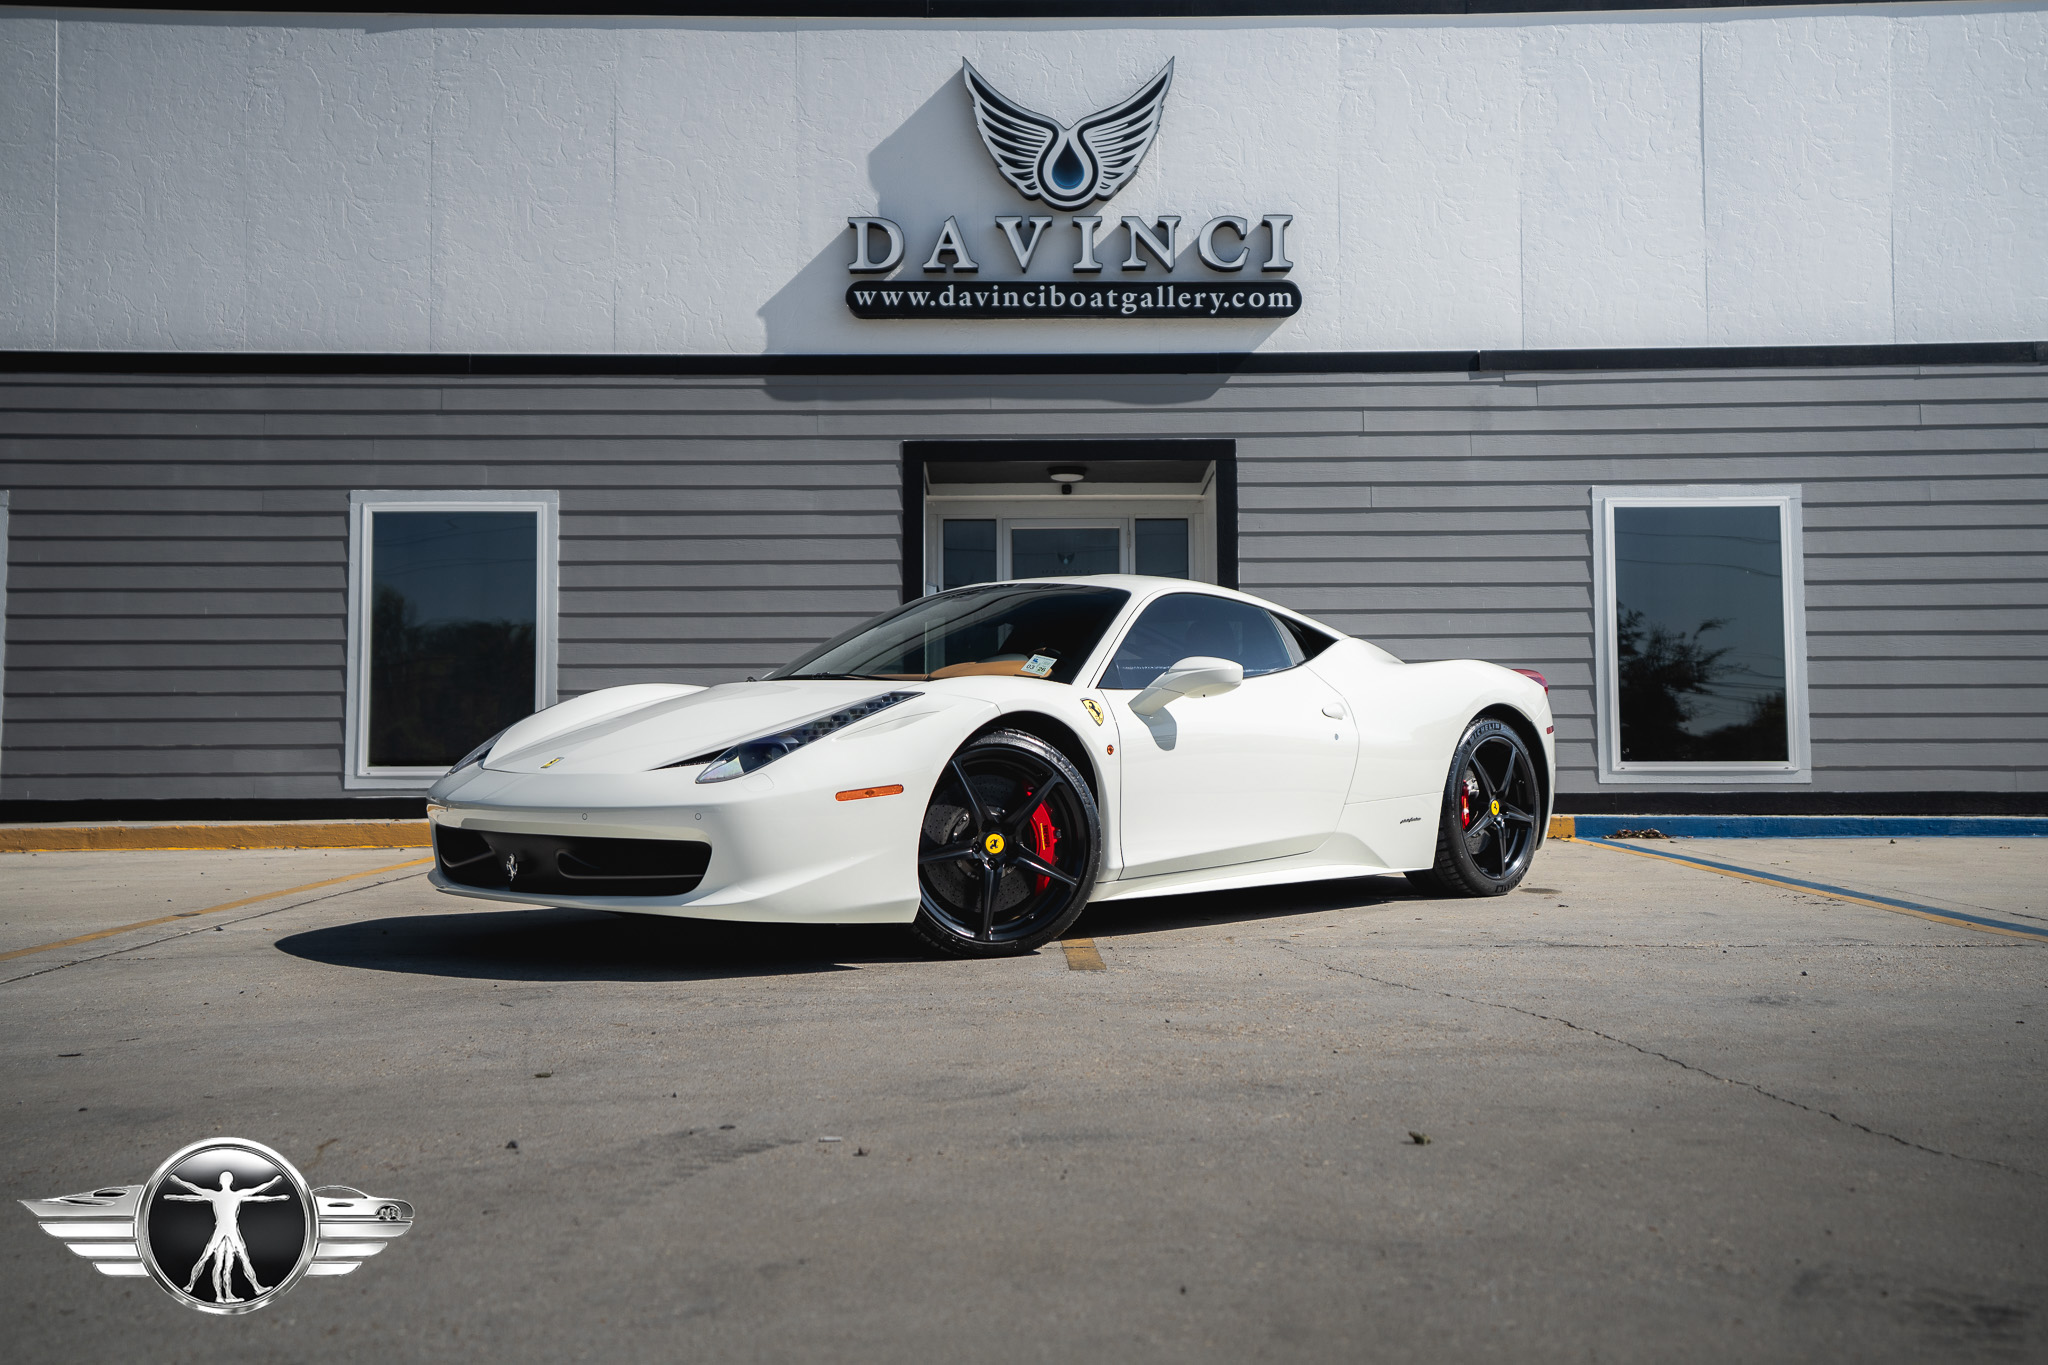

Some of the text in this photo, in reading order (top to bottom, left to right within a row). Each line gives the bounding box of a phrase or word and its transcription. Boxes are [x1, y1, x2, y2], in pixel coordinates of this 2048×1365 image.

[847, 215, 1294, 274] DAVINCI
[853, 285, 1294, 315] www.davinciboatgallery.com
[1469, 723, 1502, 743] MICHELIN
